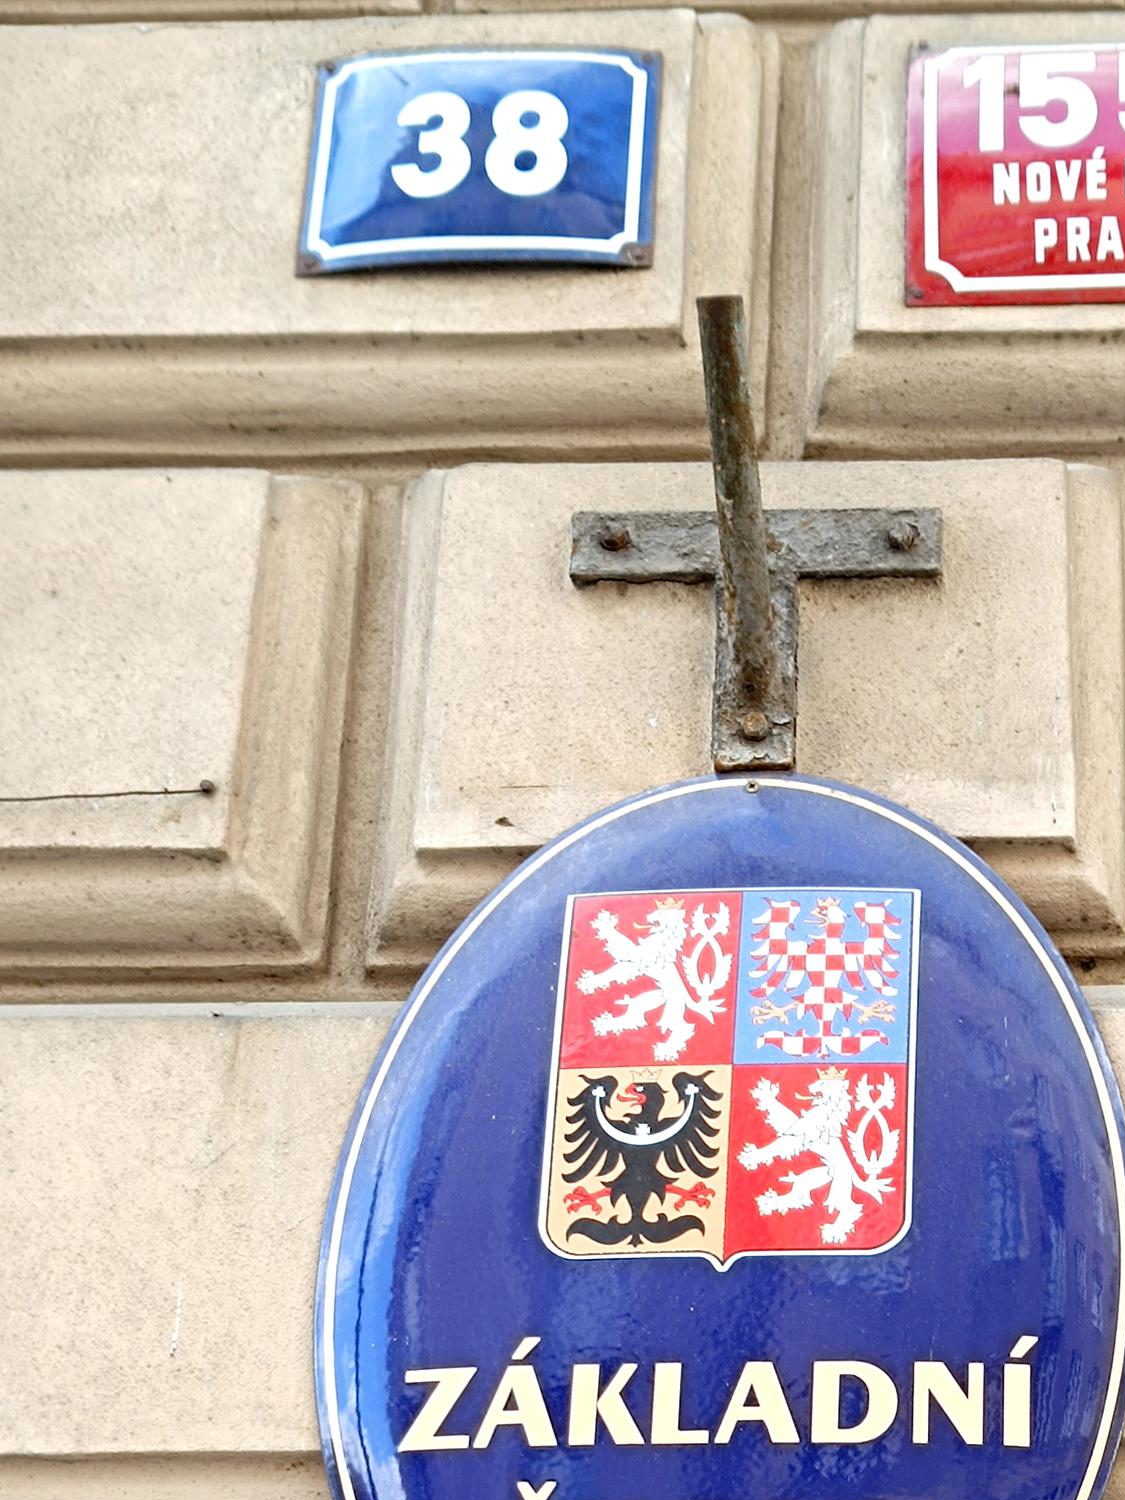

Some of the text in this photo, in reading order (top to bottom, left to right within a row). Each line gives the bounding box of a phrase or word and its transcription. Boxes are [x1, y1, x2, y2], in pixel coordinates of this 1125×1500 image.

[389, 89, 571, 199] 38
[993, 146, 1107, 205] NOVÉ
[398, 1336, 1040, 1454] ZÁKLADNÍ
